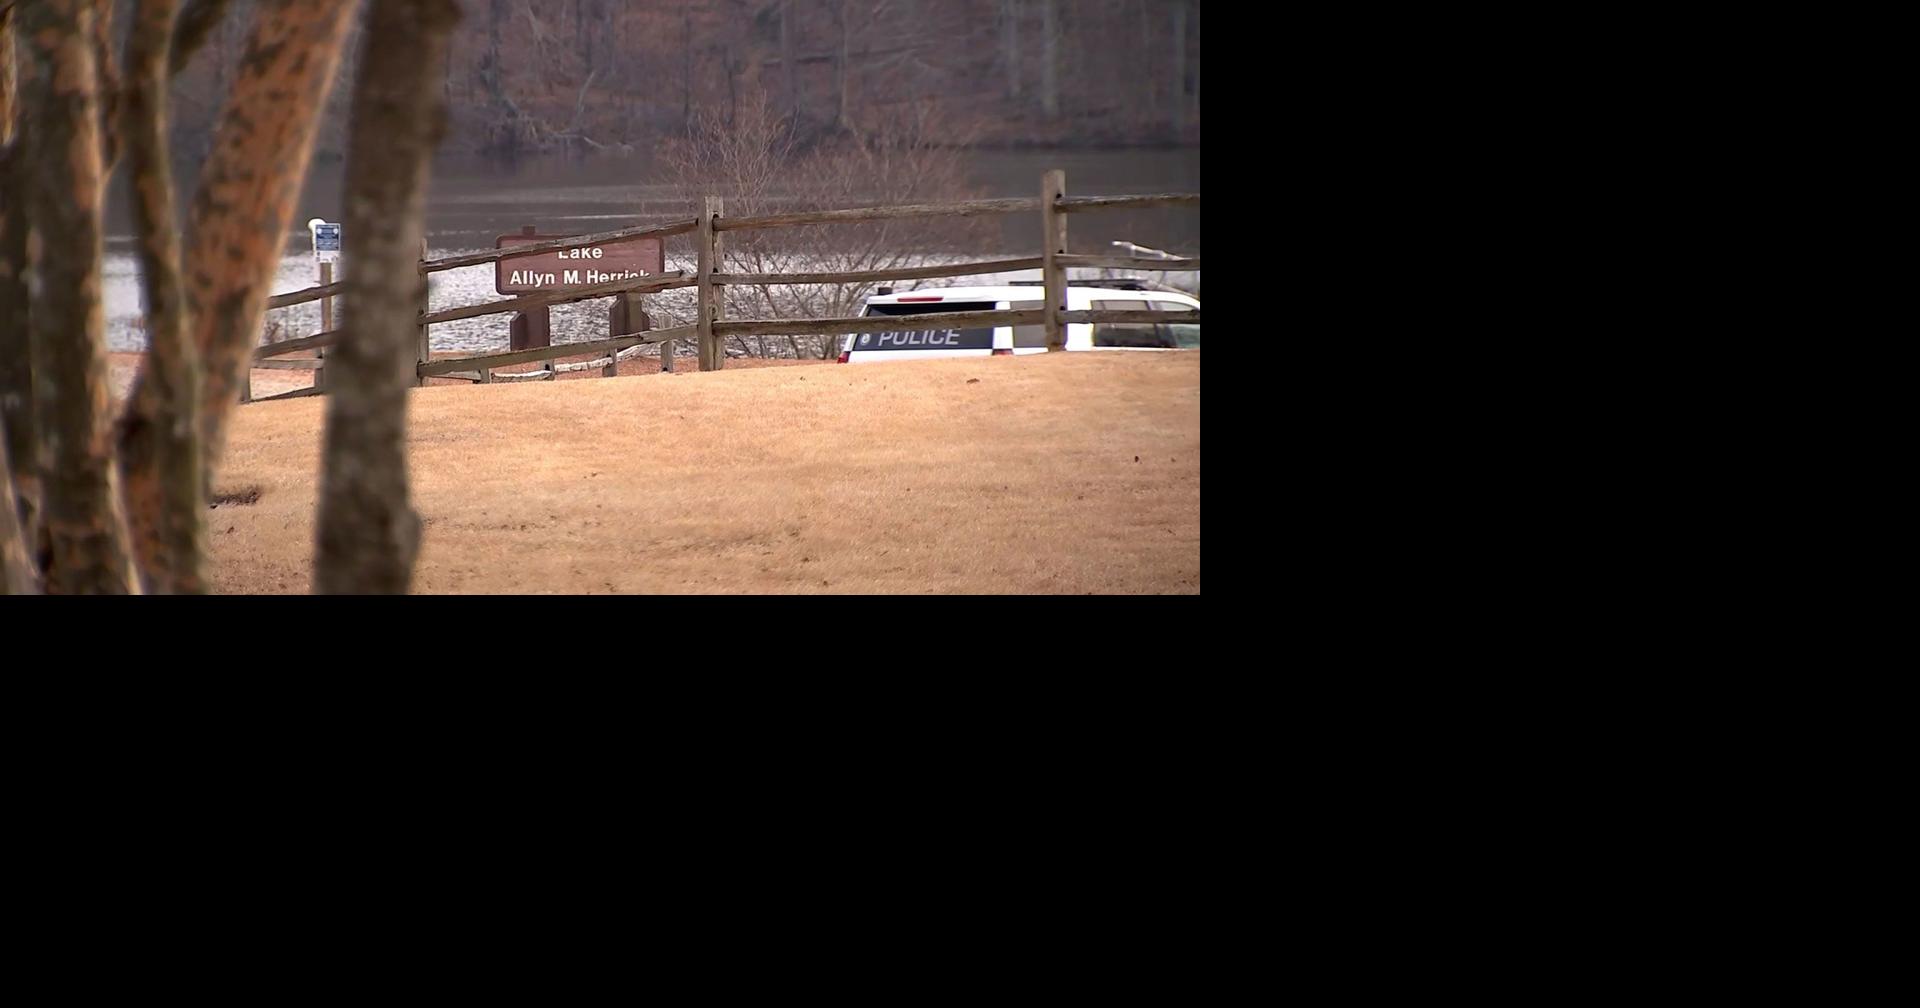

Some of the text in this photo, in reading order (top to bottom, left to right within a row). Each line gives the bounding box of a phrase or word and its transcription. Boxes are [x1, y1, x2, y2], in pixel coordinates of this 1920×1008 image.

[510, 270, 555, 287] Allyn
[563, 270, 582, 285] M.
[878, 329, 961, 346] POLICE
